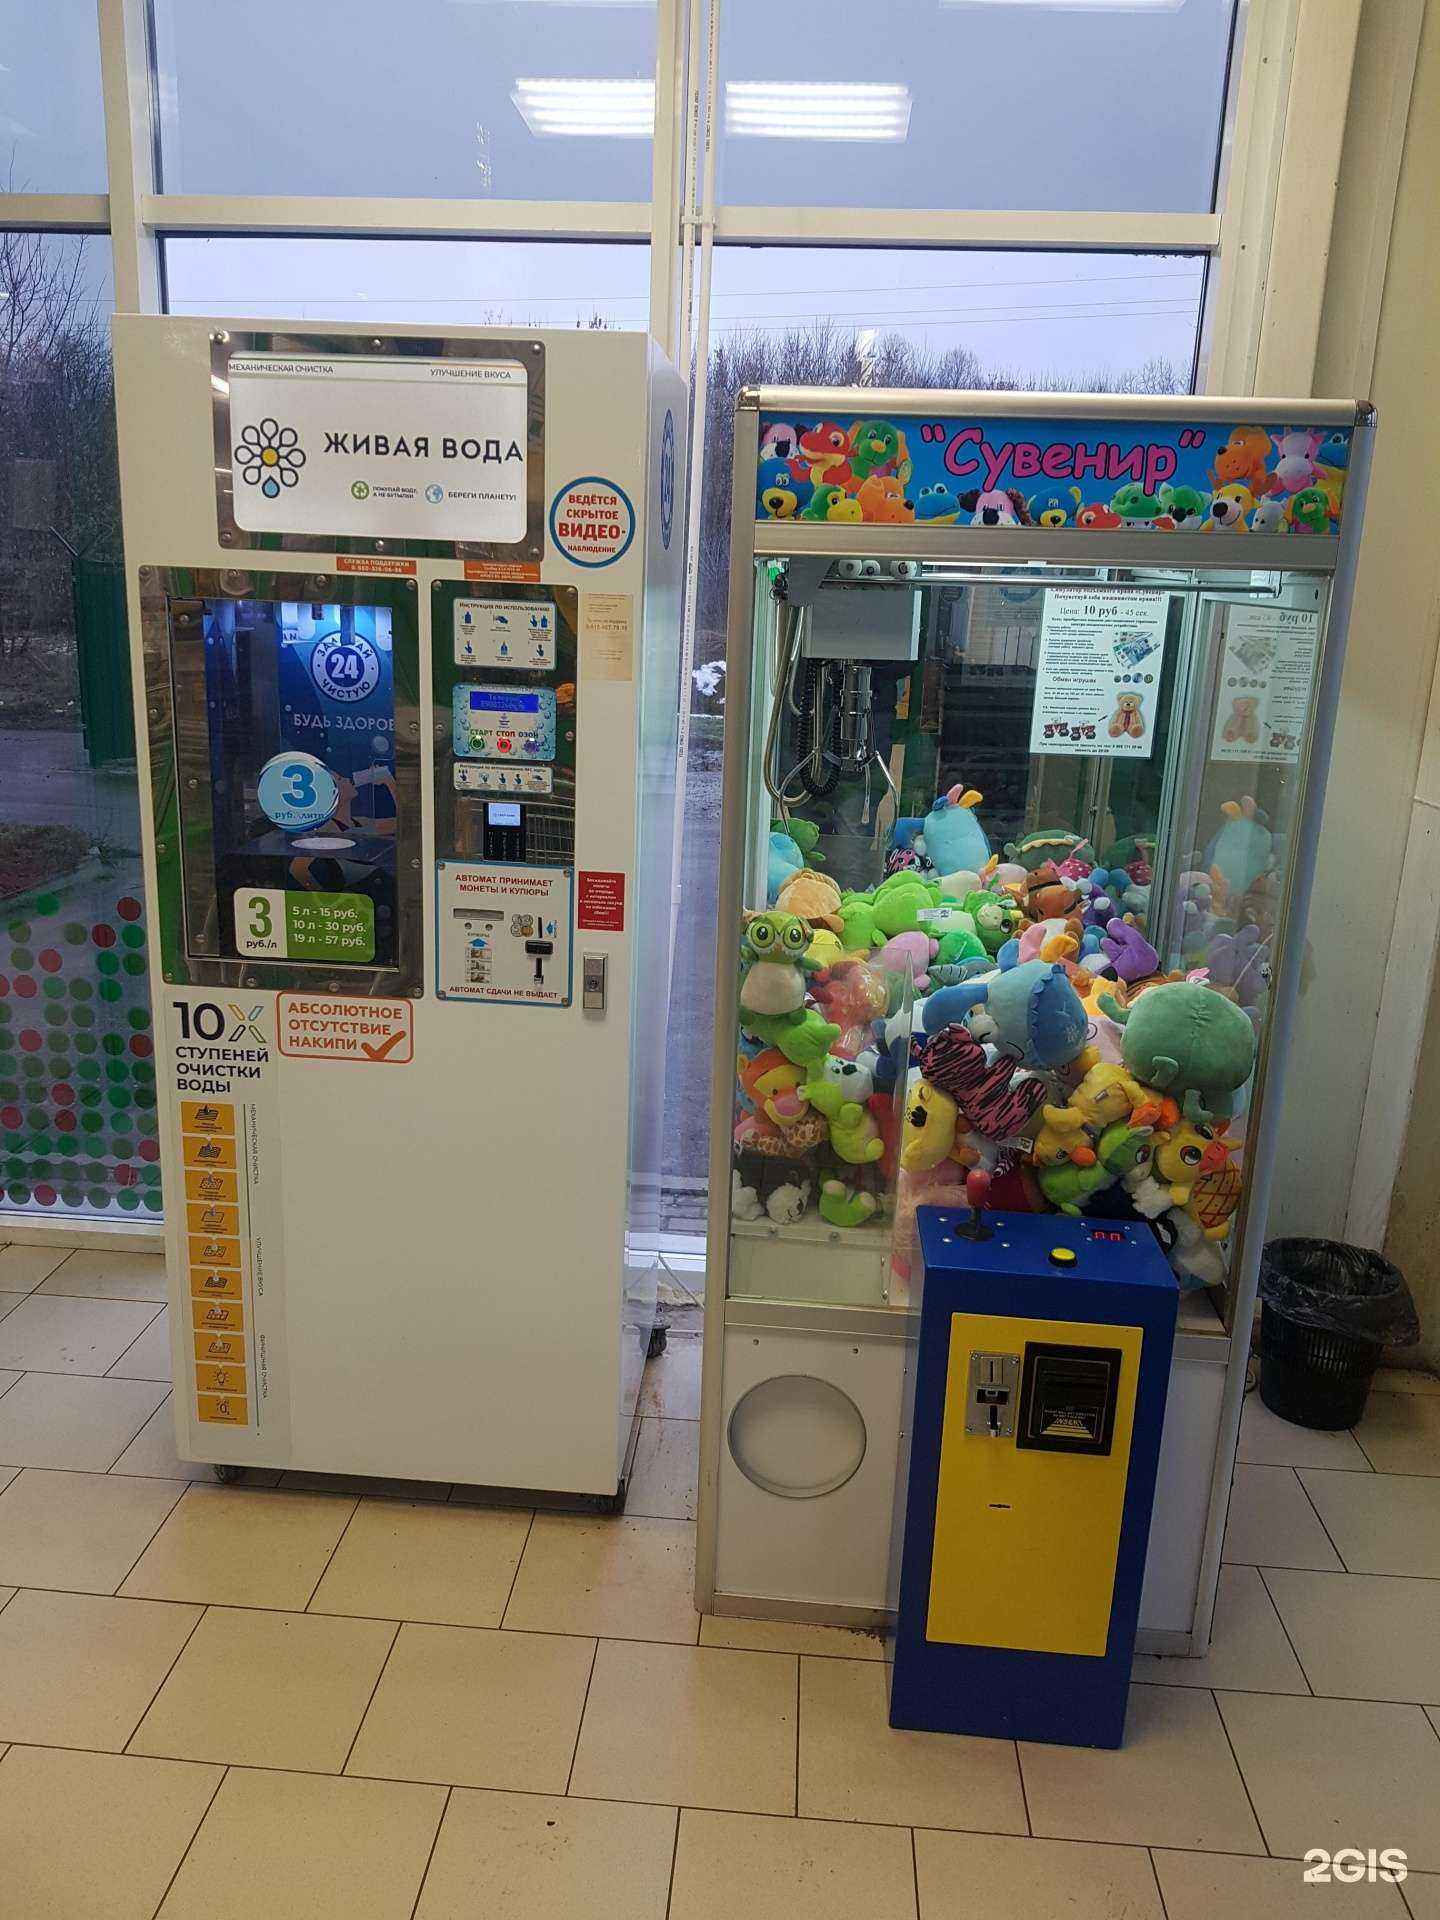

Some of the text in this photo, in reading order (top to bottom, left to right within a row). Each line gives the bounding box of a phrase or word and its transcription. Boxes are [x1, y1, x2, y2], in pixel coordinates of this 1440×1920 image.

[229, 362, 334, 374] МЕХАНИЧЕСКАЯ ОЧИСТКА
[430, 368, 511, 380] УЛУЧШЕНИЕ ВКУСА
[323, 431, 524, 465] ЖИВАЯ ВОДА
[448, 491, 517, 501] БЕРЕГИ ПЛАНЕТУ!
[568, 493, 617, 506] ВЕДЁТСЯ
[566, 509, 619, 520] СКРЫТОЕ
[558, 522, 626, 541] ВИДЕО-
[567, 545, 616, 554] НАБЛЮДЕНИЕ
[1060, 607, 1080, 616] Цена:
[1084, 605, 1096, 615] 10
[1098, 606, 1118, 617] руб
[330, 653, 359, 679] 24
[321, 679, 371, 698] ЧИСТУЮ
[293, 714, 332, 728] БУДЬ
[281, 764, 318, 808] 3
[455, 874, 553, 887] АВТОМАТ ПРИНИМАЕТ
[459, 884, 498, 893] МОНЕТЫ
[509, 887, 549, 896] КУПЮРЫ
[248, 896, 272, 938] 3
[292, 906, 300, 915] 5
[302, 907, 310, 915] л
[320, 908, 330, 917] 15
[334, 907, 358, 919] руб.
[294, 920, 305, 929] 10
[308, 921, 316, 930] л
[325, 922, 339, 931] 30
[342, 922, 367, 933] руб.
[246, 938, 277, 949] руб./л
[294, 933, 305, 943] 19
[308, 935, 316, 943] л
[325, 936, 339, 945] 57
[341, 936, 366, 947] руб.
[449, 986, 485, 994] АВТОМАТ
[486, 987, 512, 995] СДАЧИ
[288, 1002, 403, 1019] АБСОЛЮТНОЕ
[288, 1019, 391, 1035] ОТСУТСТВИЕ
[288, 1036, 357, 1050] НАКИПИ
[176, 1046, 269, 1063] СТУПЕНЕЙ
[176, 1063, 261, 1079] ОЧИСТКИ
[176, 1079, 231, 1094] ВОДЫ
